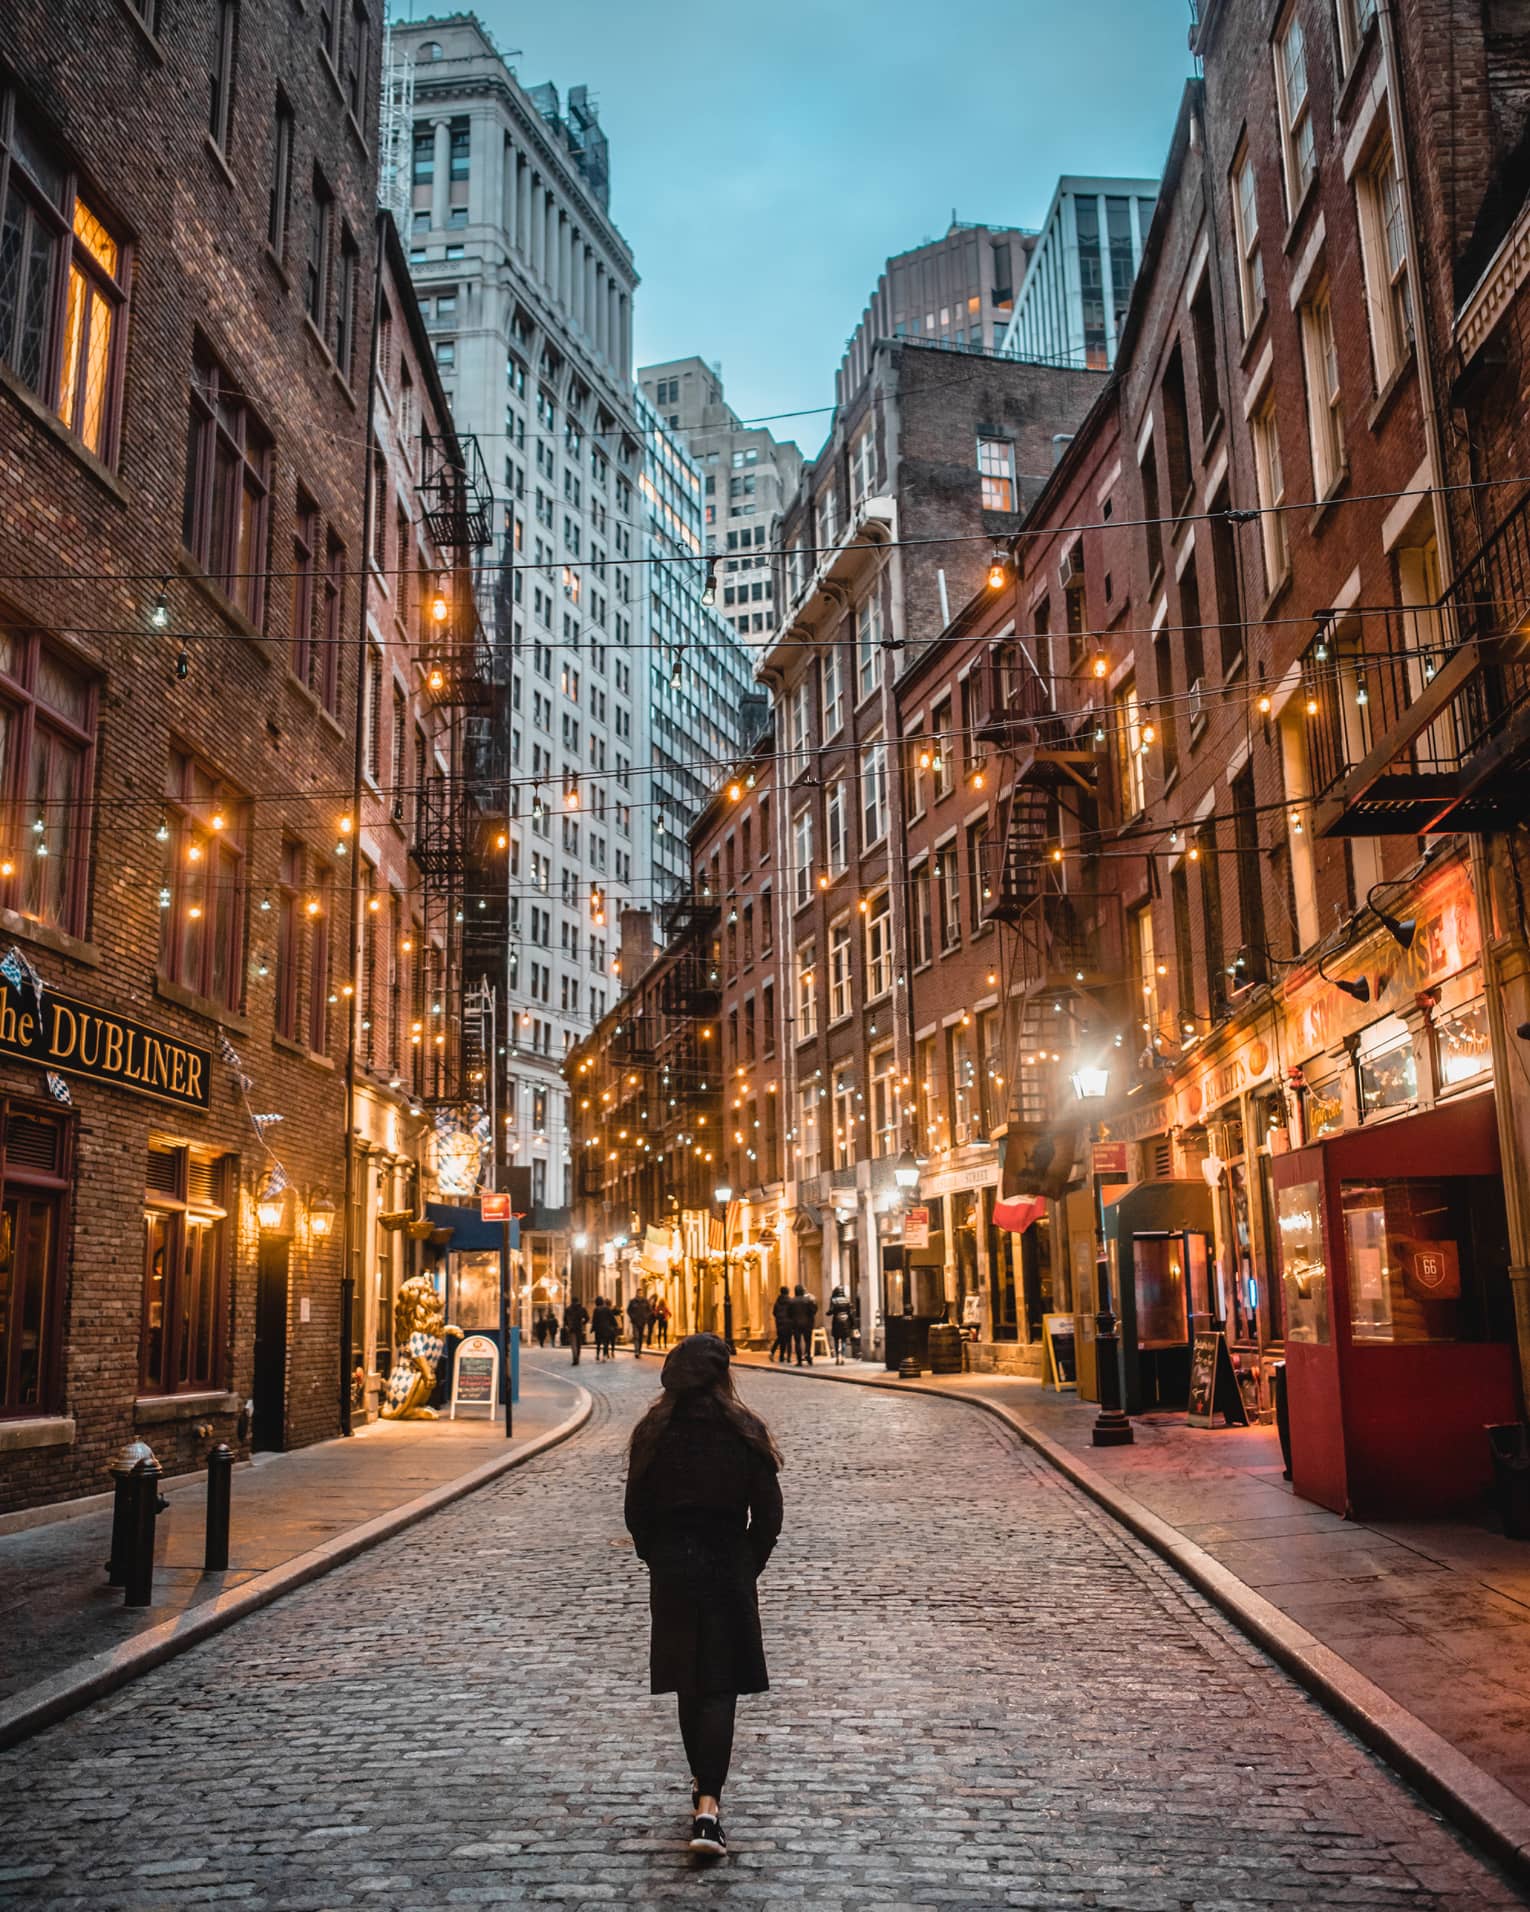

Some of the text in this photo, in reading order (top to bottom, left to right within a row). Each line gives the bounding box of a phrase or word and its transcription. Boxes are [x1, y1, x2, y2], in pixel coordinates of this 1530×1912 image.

[0, 986, 203, 1100] he DUBLINER
[1423, 1259, 1437, 1275] 66
